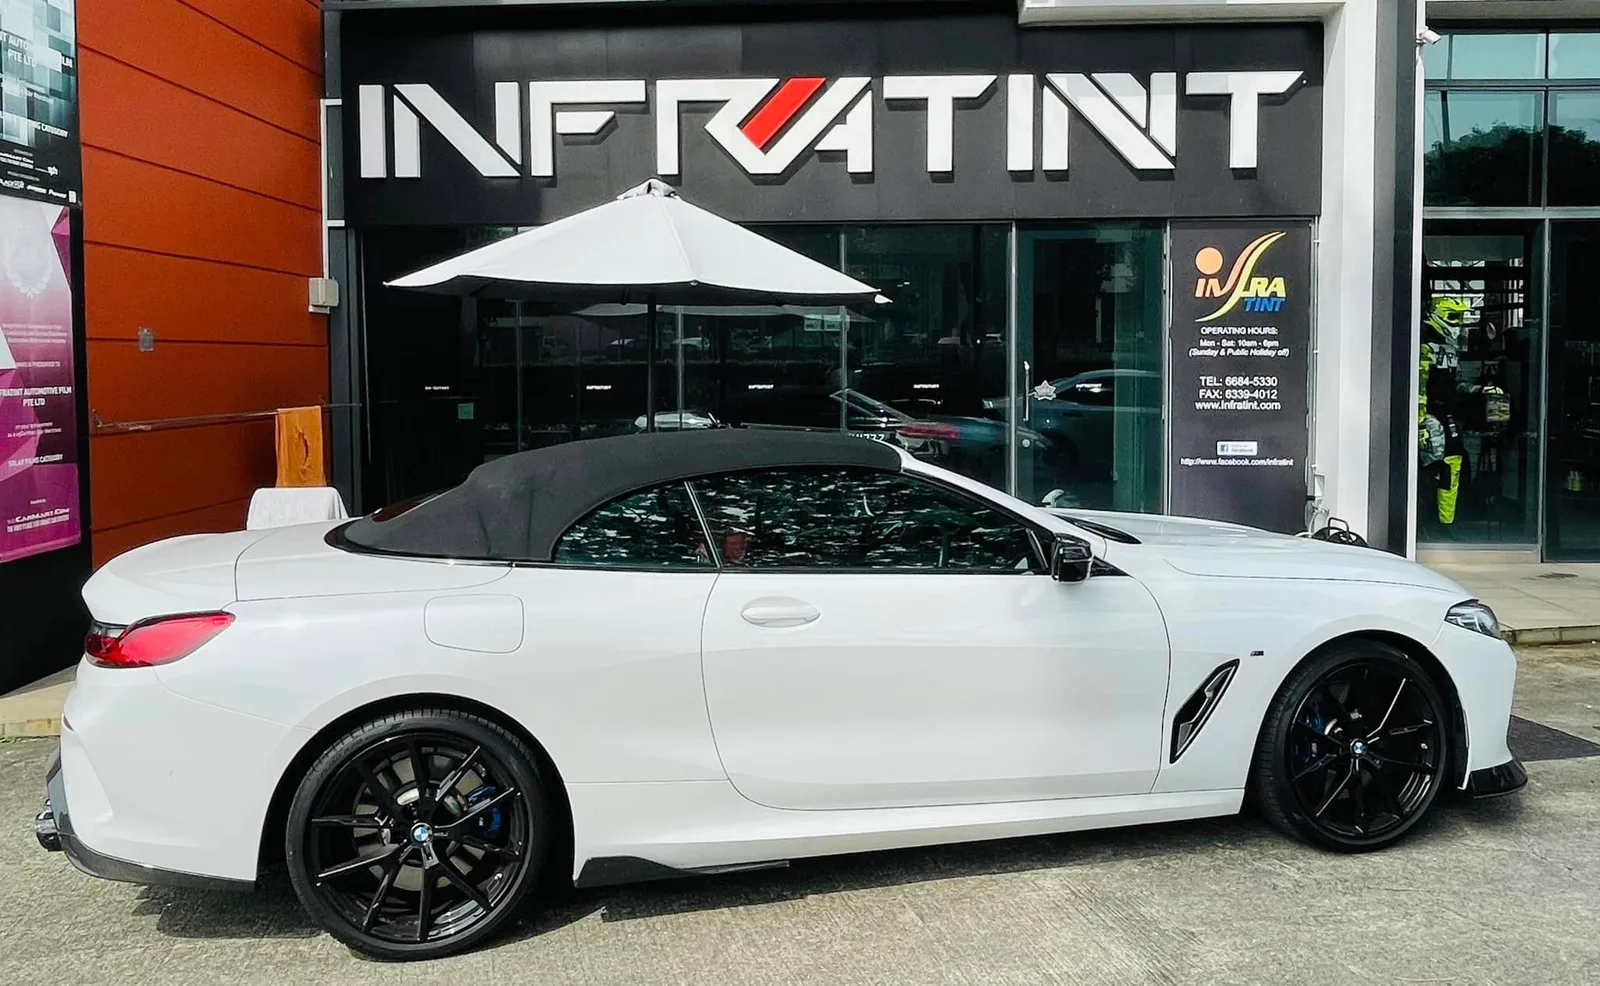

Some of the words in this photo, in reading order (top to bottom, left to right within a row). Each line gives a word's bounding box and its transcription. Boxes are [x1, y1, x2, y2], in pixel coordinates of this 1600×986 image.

[8, 48, 22, 63] PTE
[24, 55, 37, 68] LTD
[359, 72, 1304, 179] INFRATINT
[1244, 297, 1286, 312] TINT
[1200, 327, 1246, 335] OPERATING
[1247, 327, 1279, 335] HOURS:
[1200, 339, 1216, 347] Mon
[1237, 339, 1258, 347] 10am
[1262, 339, 1279, 348] 6pm
[1188, 348, 1219, 357] (Sunday
[1226, 348, 1249, 356] Public
[1249, 348, 1277, 357] Holiday
[1199, 376, 1223, 387] TEL:
[1225, 376, 1278, 387] 6684-5330
[1199, 389, 1223, 399] FAX:
[1225, 389, 1278, 400] 6339-4012
